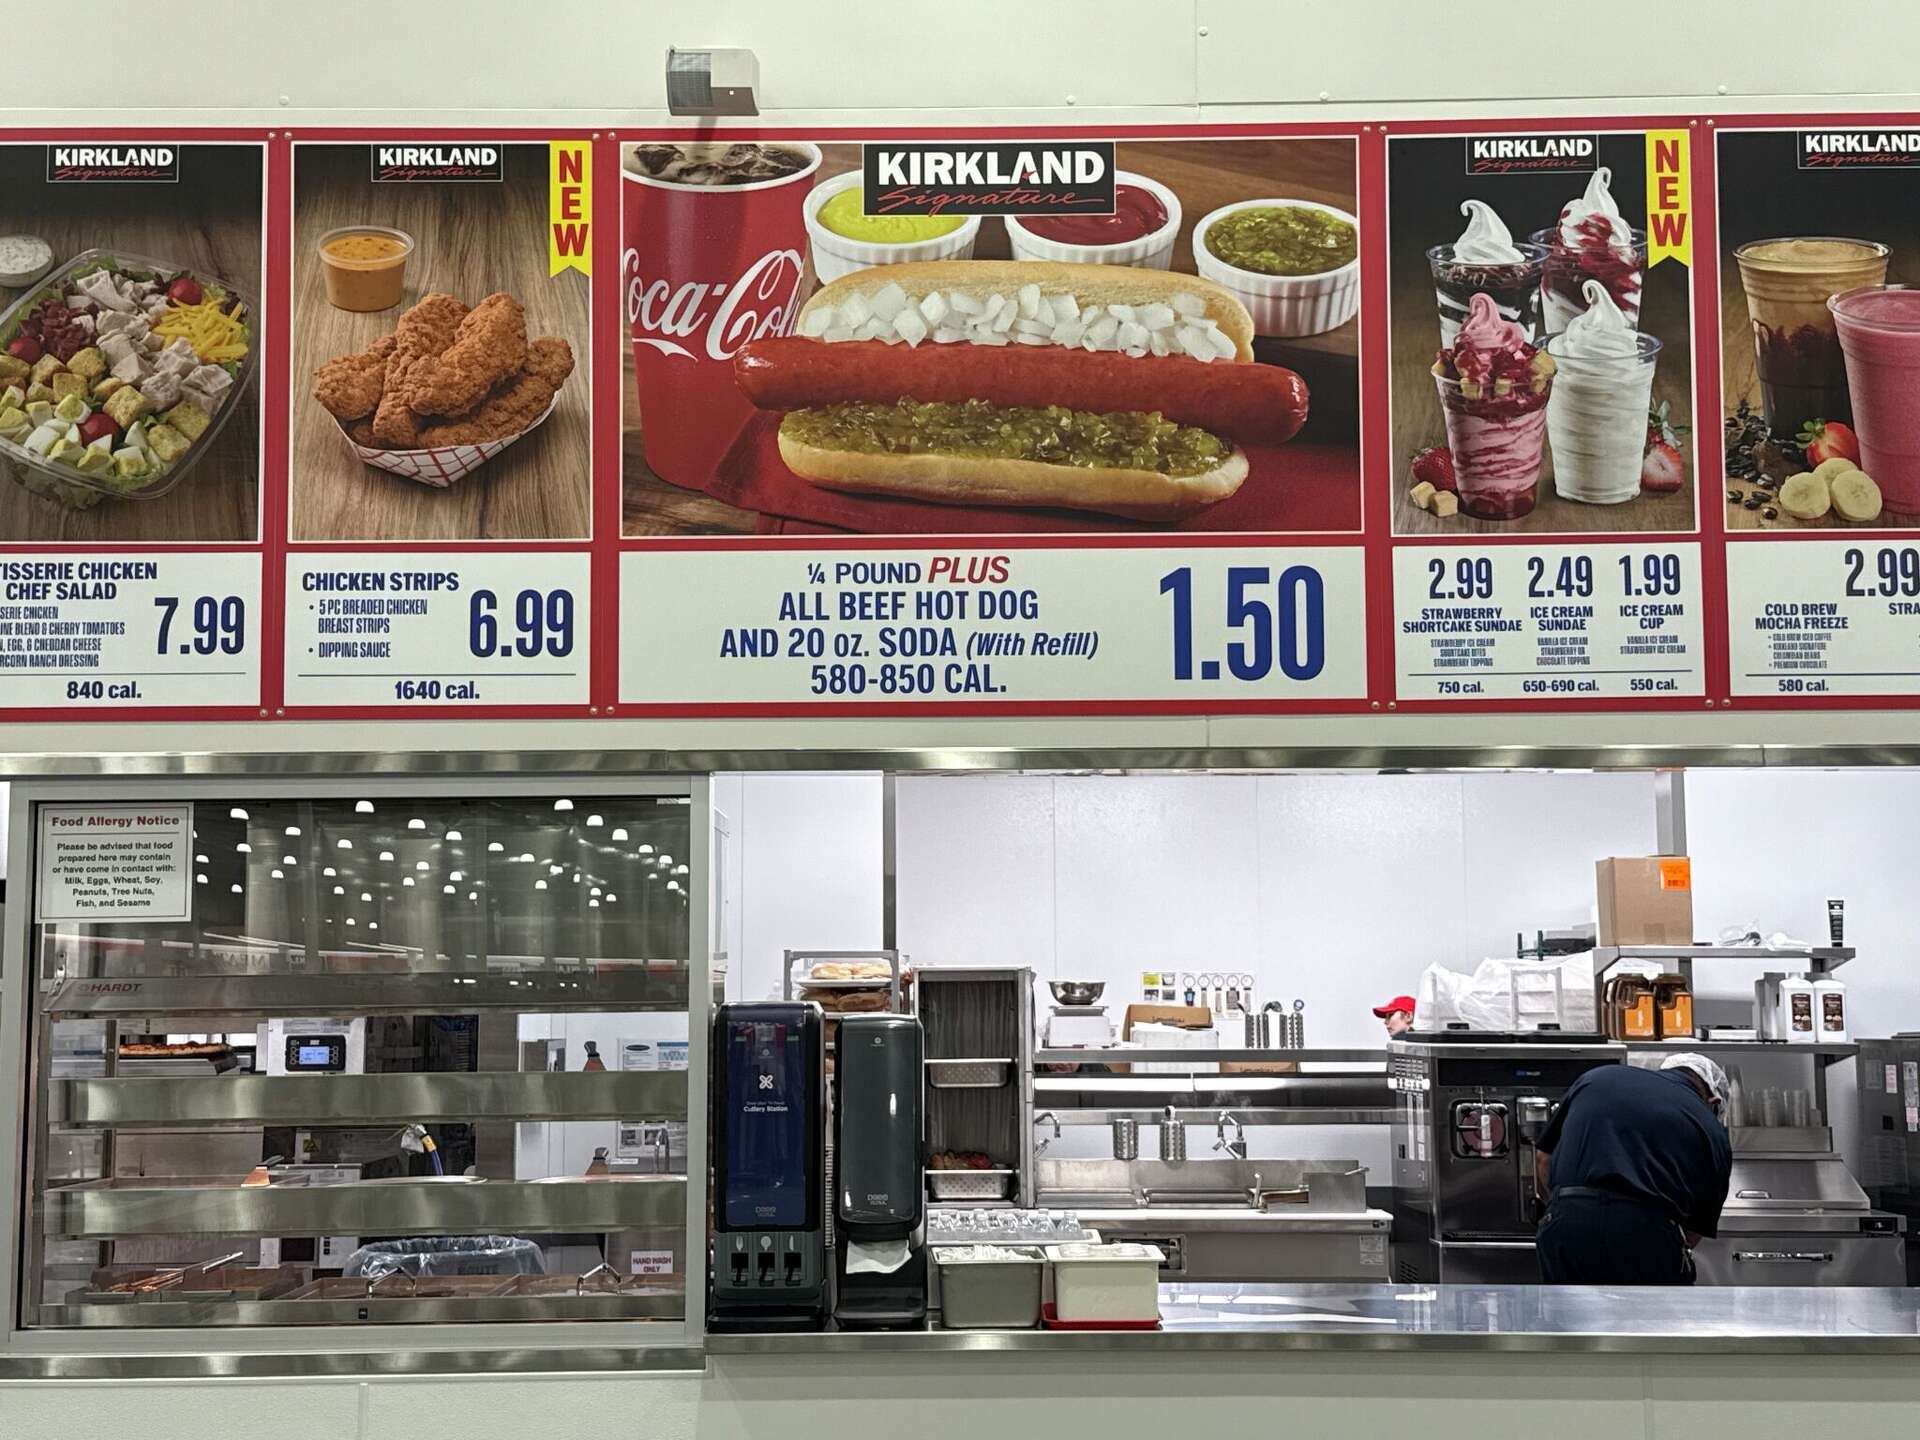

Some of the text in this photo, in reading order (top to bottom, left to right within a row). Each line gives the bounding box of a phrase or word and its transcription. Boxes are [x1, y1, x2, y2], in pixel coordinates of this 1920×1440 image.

[1474, 138, 1592, 157] KIRKLAND
[55, 148, 173, 166] KIRKLAND
[380, 147, 497, 166] KIRKLAND
[1806, 153, 1920, 168] Signature
[378, 165, 497, 178] Signature
[878, 151, 1105, 185] KIRKLAND
[1473, 157, 1593, 172] Signature
[54, 166, 173, 179] Signature
[877, 185, 1104, 215] Signature
[1654, 140, 1687, 247] NEW
[553, 149, 589, 256] NEW
[0, 562, 157, 582] ISSERIE CHICKEN
[836, 563, 921, 584] POUND
[925, 554, 1013, 586] PLUS
[1528, 556, 1593, 597] 2.49
[1619, 554, 1680, 595] 1.99
[1845, 548, 1920, 597] 2.99
[303, 572, 459, 591] CHICKEN STRIPS
[1429, 558, 1492, 599] 2.99
[6, 582, 116, 600] CHEF SALAD
[320, 599, 427, 615] 5 PC BREADED CHICKEN
[779, 590, 1038, 620] ALL BEEF HOT DOG
[1531, 606, 1593, 618] ICE CREAM
[1620, 604, 1683, 616] ICE CREAM
[1765, 603, 1837, 616] COLD BREW
[24, 607, 58, 619] CHICKEN
[1422, 608, 1502, 620] STRAWBERRY
[15, 623, 40, 635] BLEND
[49, 622, 80, 635] CHERRY
[82, 622, 124, 635] TOMATOES
[155, 596, 244, 655] 7.99
[319, 618, 389, 633] BREAST STRIPS
[470, 590, 573, 657] 6.99
[1160, 566, 1324, 681] 1.50
[1403, 619, 1522, 633] SHORTCAKE SUNDAE
[1538, 619, 1587, 631] SUNDAE
[1640, 618, 1665, 630] CUP
[1756, 617, 1848, 630] MOCHA FREEZE
[34, 638, 70, 651] CHEDDAR
[73, 638, 101, 651] CHEESE
[319, 642, 390, 657] DIPPING SAUCE
[720, 627, 1098, 660] AND 20 oz. SODA (With Refill)
[29, 655, 56, 667] RANCH
[59, 654, 98, 667] DRESSING
[812, 664, 1006, 694] 580-850 CAL.
[1523, 680, 1599, 692] 650-690 cal.
[1631, 679, 1677, 690] 550 cal.
[1779, 680, 1828, 691] 580 cal.
[67, 681, 141, 699] 840 cal.
[395, 681, 479, 699] 1640 cal.
[1438, 681, 1484, 693] 750 cal.
[52, 816, 179, 827] Food Allergy Notice
[59, 855, 96, 863] prepared
[87, 877, 110, 886] Eggs,
[90, 983, 142, 992] HARDT
[633, 1257, 672, 1265] HAND WASH
[643, 1265, 660, 1273] ONLY
